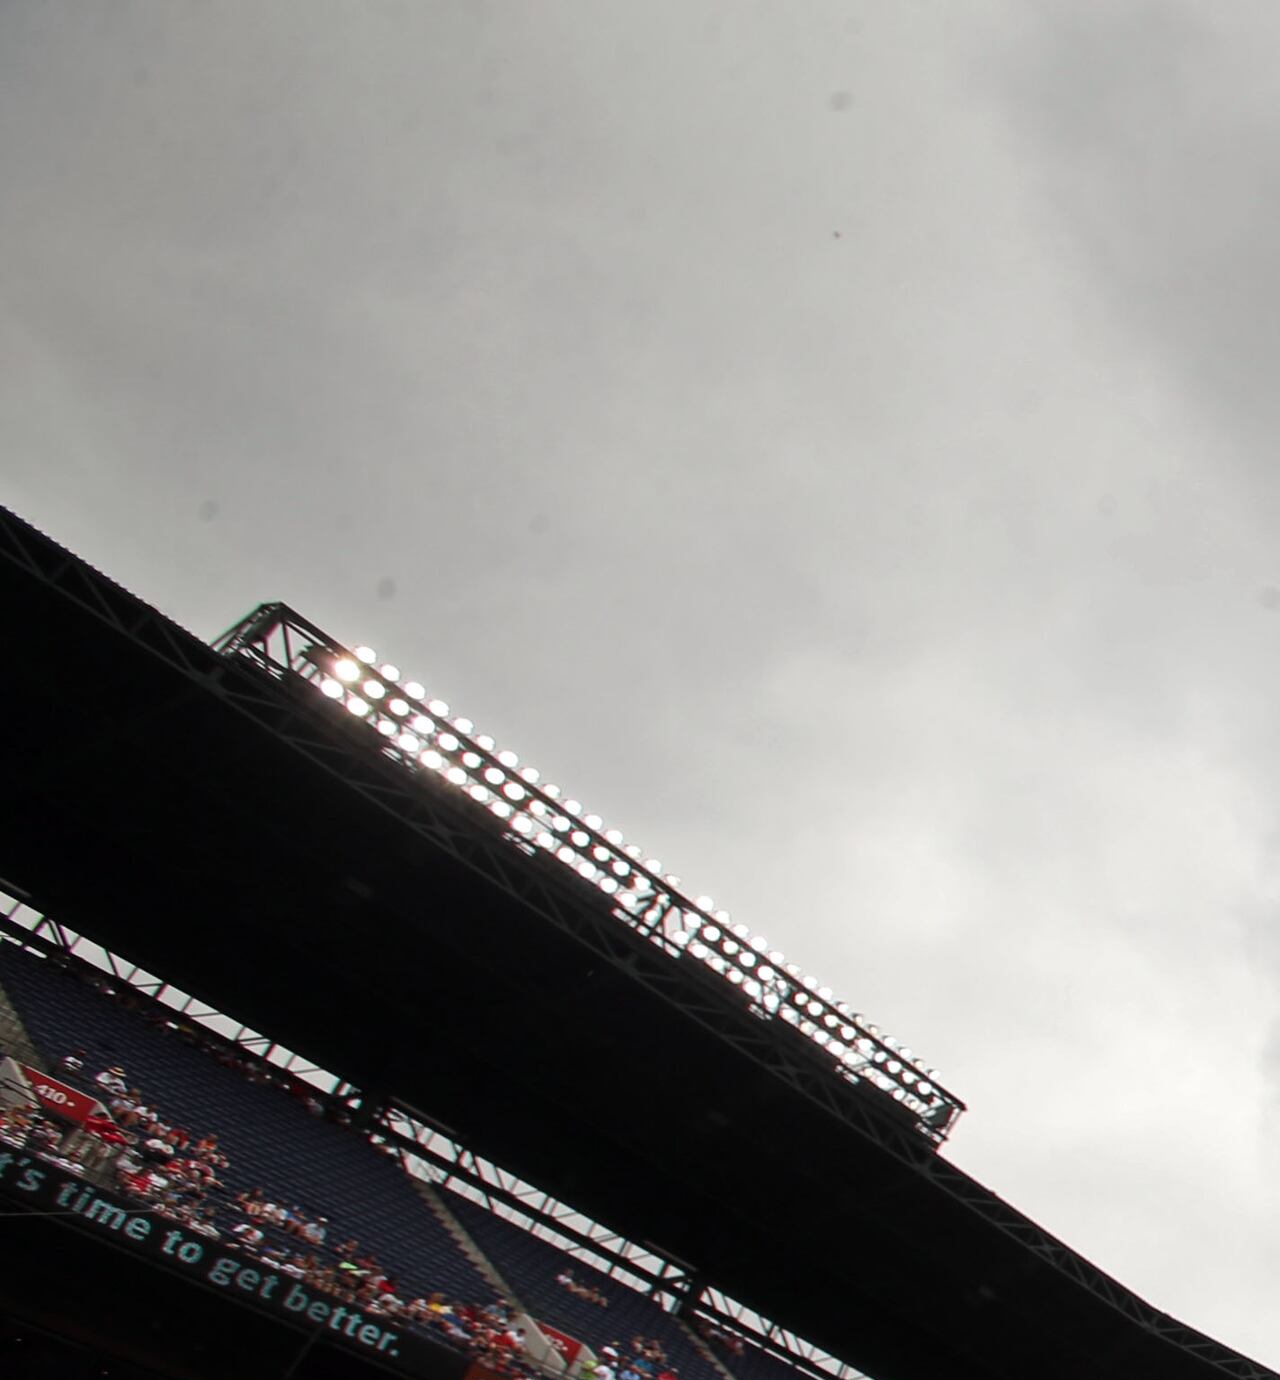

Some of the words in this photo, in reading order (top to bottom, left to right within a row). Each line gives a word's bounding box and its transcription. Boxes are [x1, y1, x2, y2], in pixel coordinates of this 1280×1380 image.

[55, 1180, 151, 1241] time
[162, 1229, 203, 1264] to
[208, 1257, 280, 1299] get
[284, 1283, 400, 1357] better.
